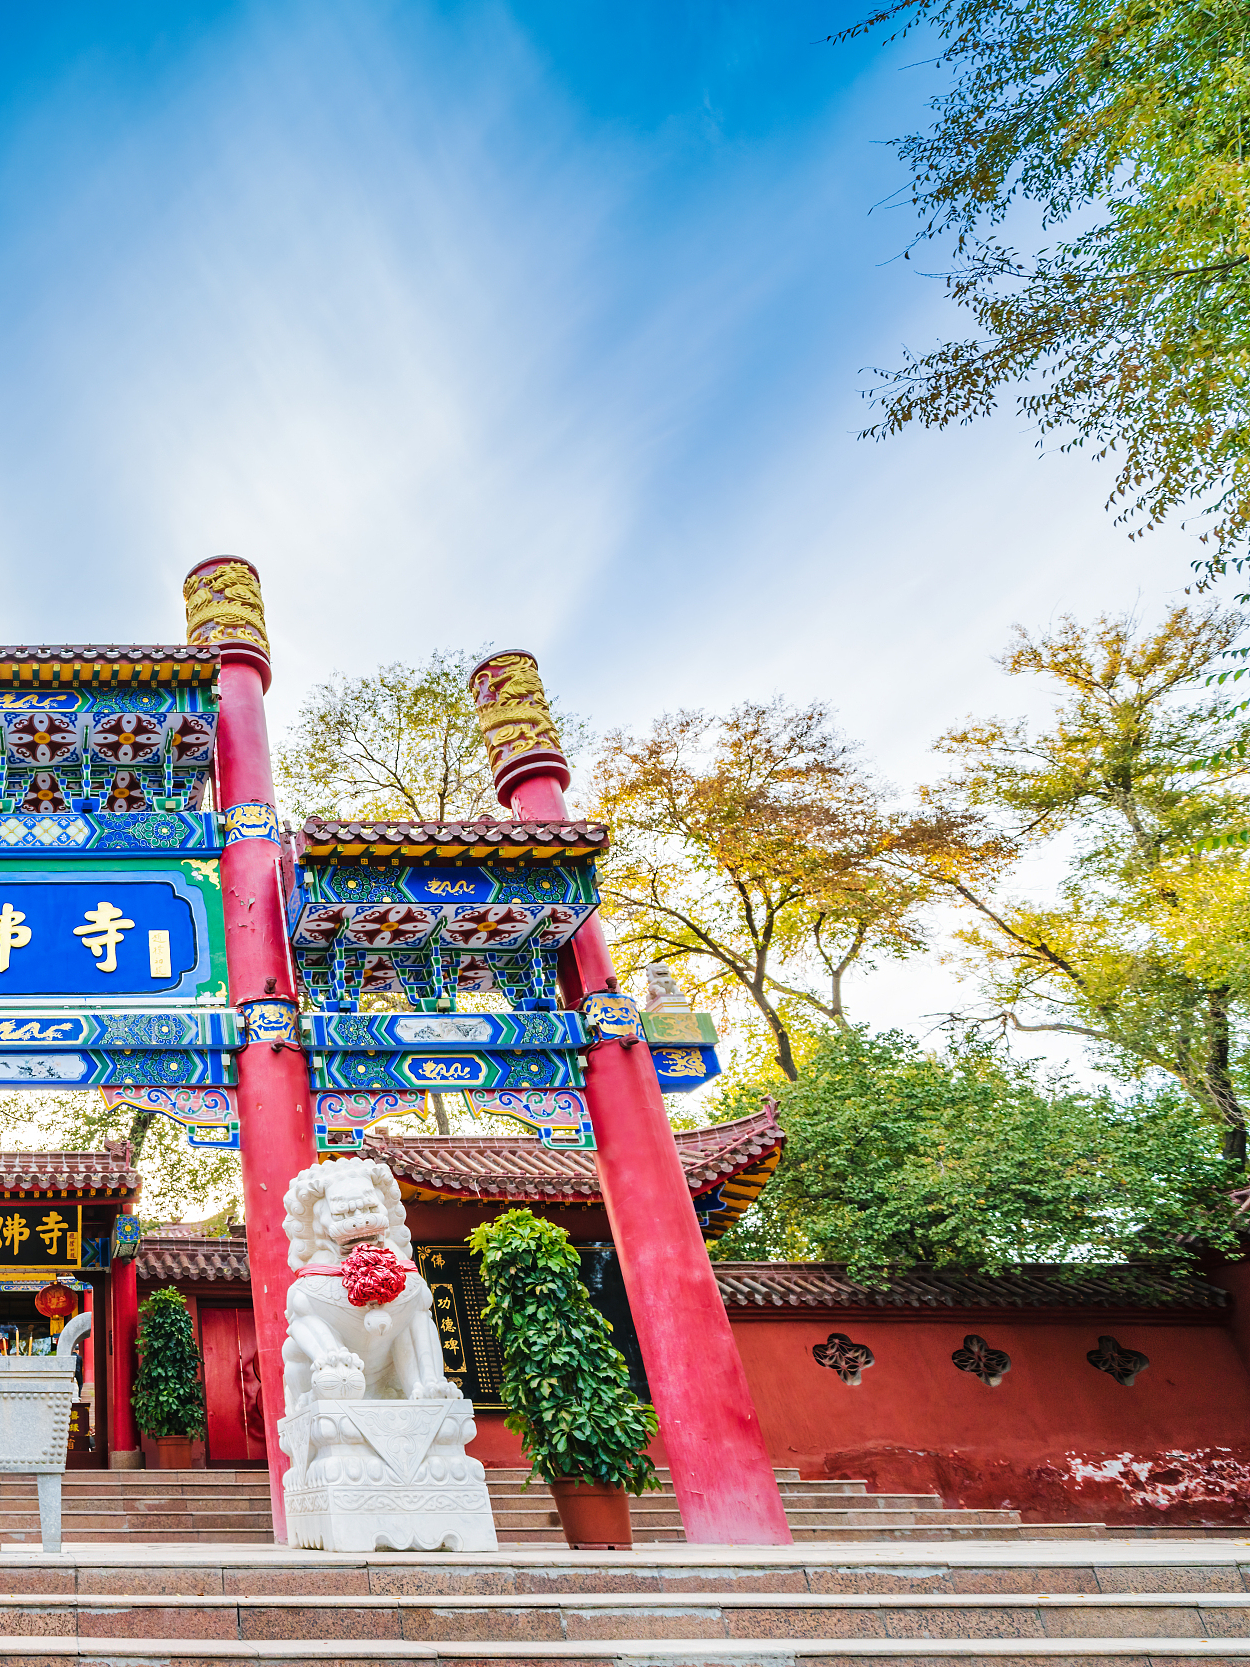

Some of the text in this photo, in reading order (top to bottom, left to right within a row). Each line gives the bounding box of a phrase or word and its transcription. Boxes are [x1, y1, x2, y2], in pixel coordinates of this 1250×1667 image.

[431, 1253, 446, 1270] 佛
[438, 1297, 460, 1355] 功德碑
